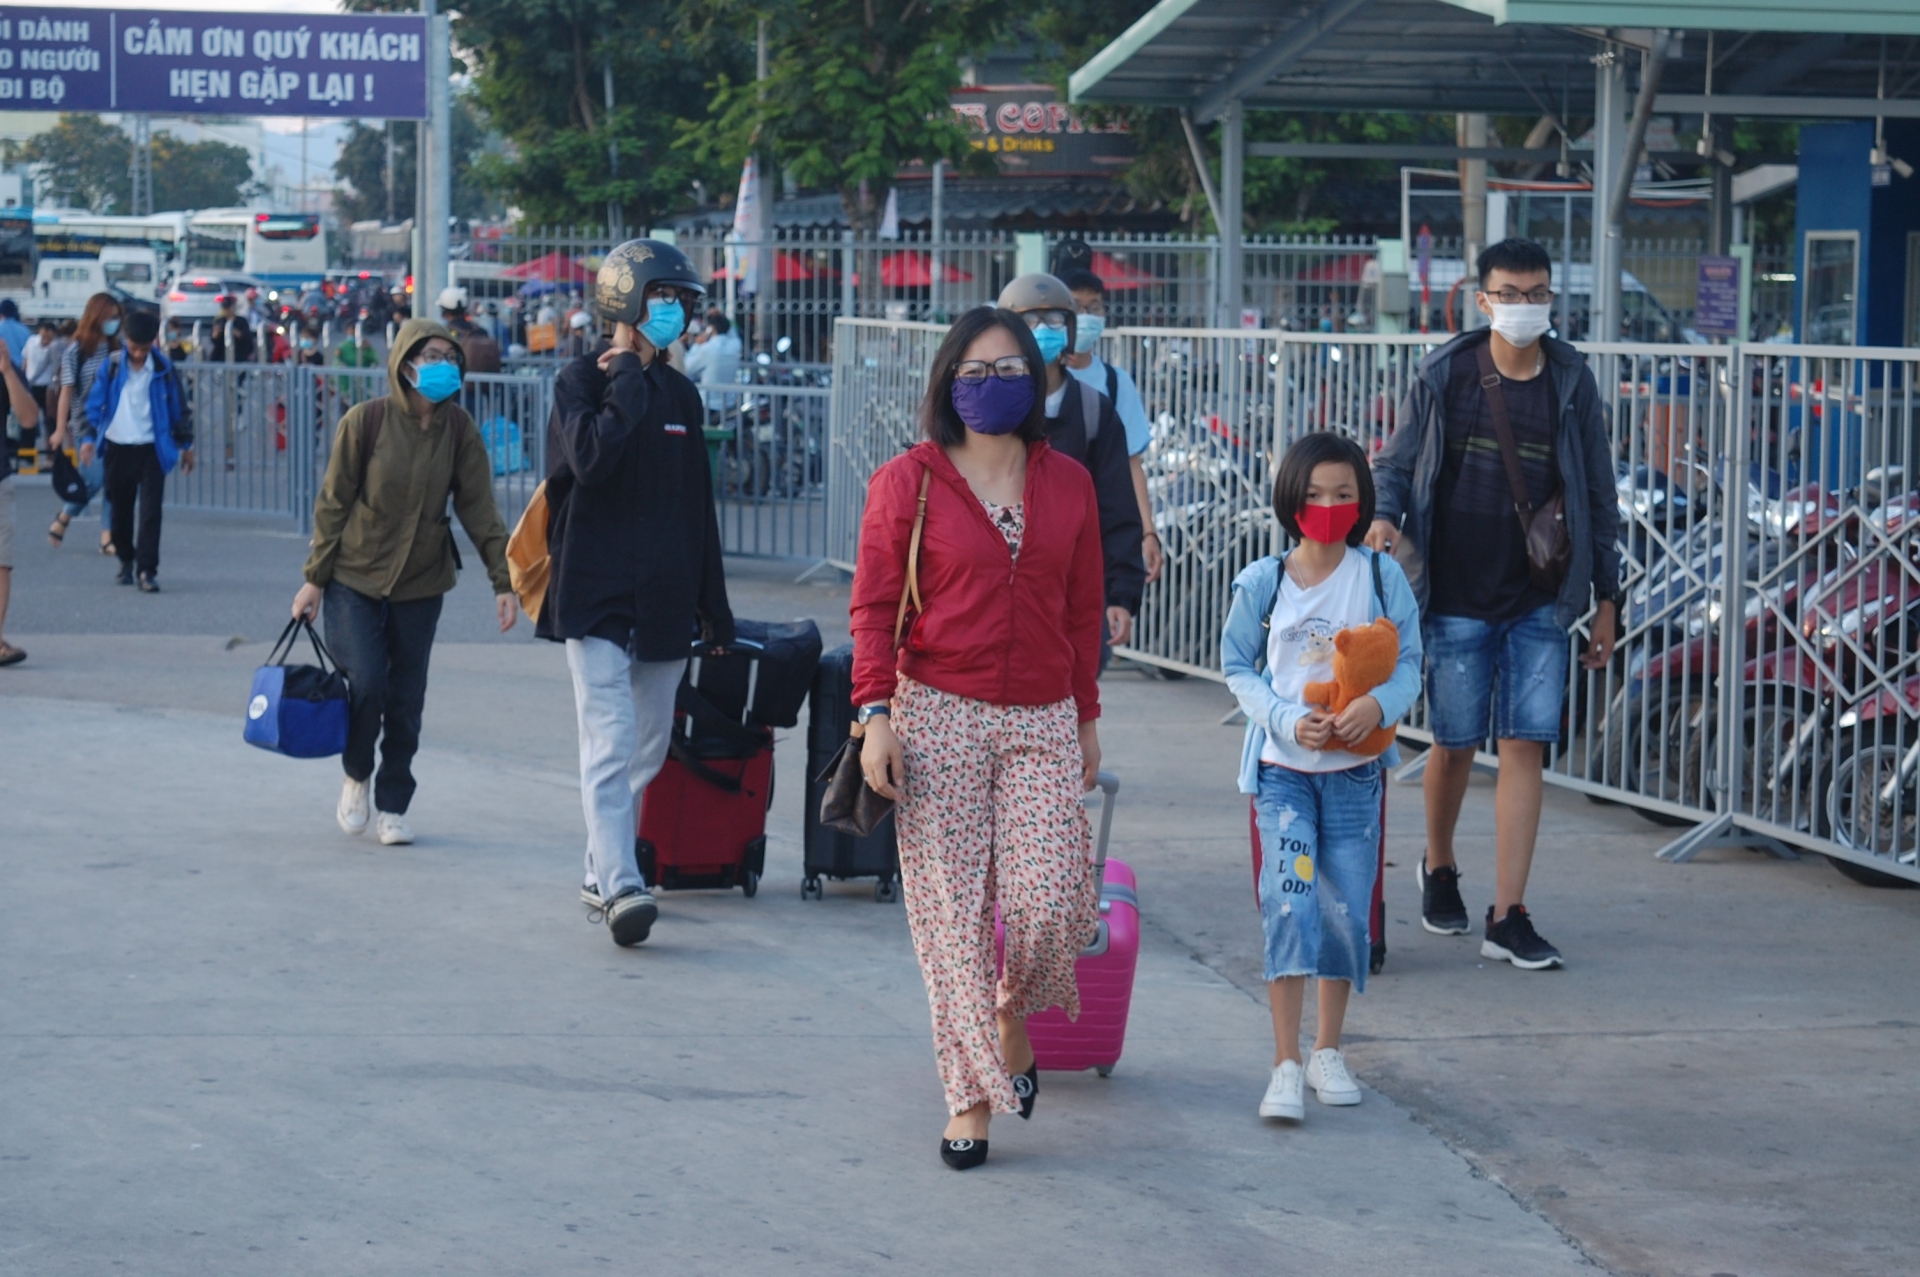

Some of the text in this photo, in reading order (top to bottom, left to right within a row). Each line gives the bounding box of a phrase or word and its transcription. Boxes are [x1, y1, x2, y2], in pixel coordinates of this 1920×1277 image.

[18, 15, 89, 42] DÀNH
[124, 17, 420, 61] CẢM ƠN QUÝ KHÁCH
[20, 45, 100, 72] NGƯỜI
[30, 74, 65, 104] BỘ
[170, 65, 374, 107] HẸN GẶP LẠI !
[986, 136, 999, 152] &
[1002, 137, 1056, 152] Drinks
[1279, 837, 1311, 857] YOU
[1282, 878, 1312, 897] OD?
